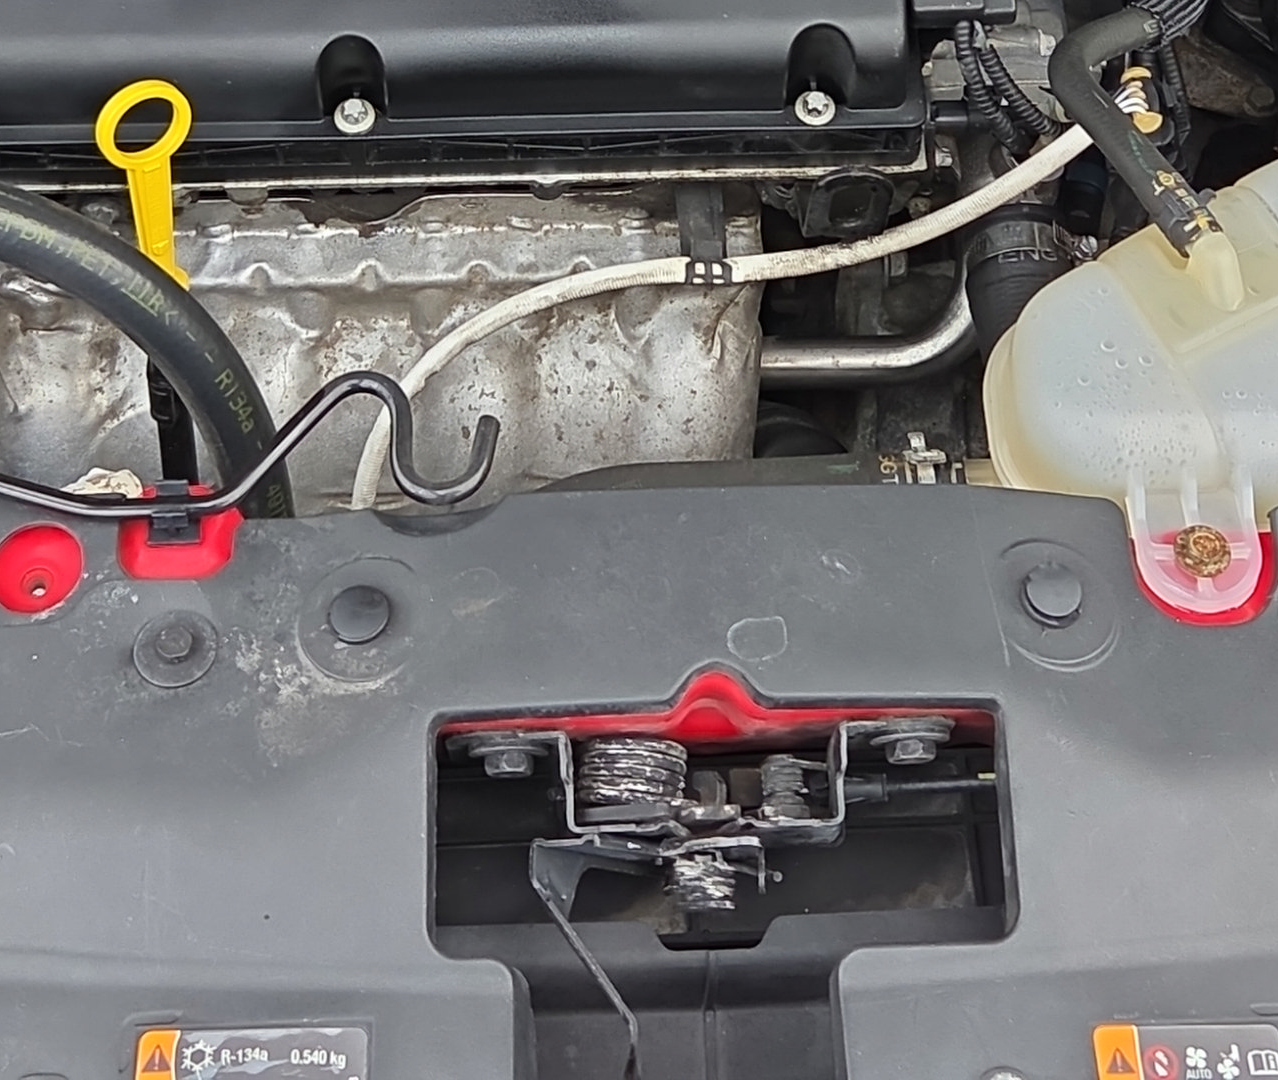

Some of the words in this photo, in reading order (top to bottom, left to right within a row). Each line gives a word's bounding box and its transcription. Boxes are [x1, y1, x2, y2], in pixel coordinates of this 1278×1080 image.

[214, 368, 255, 434] R134a
[221, 1047, 268, 1066] R-134a
[290, 1048, 327, 1065] 0.540
[330, 1050, 347, 1069] kg
